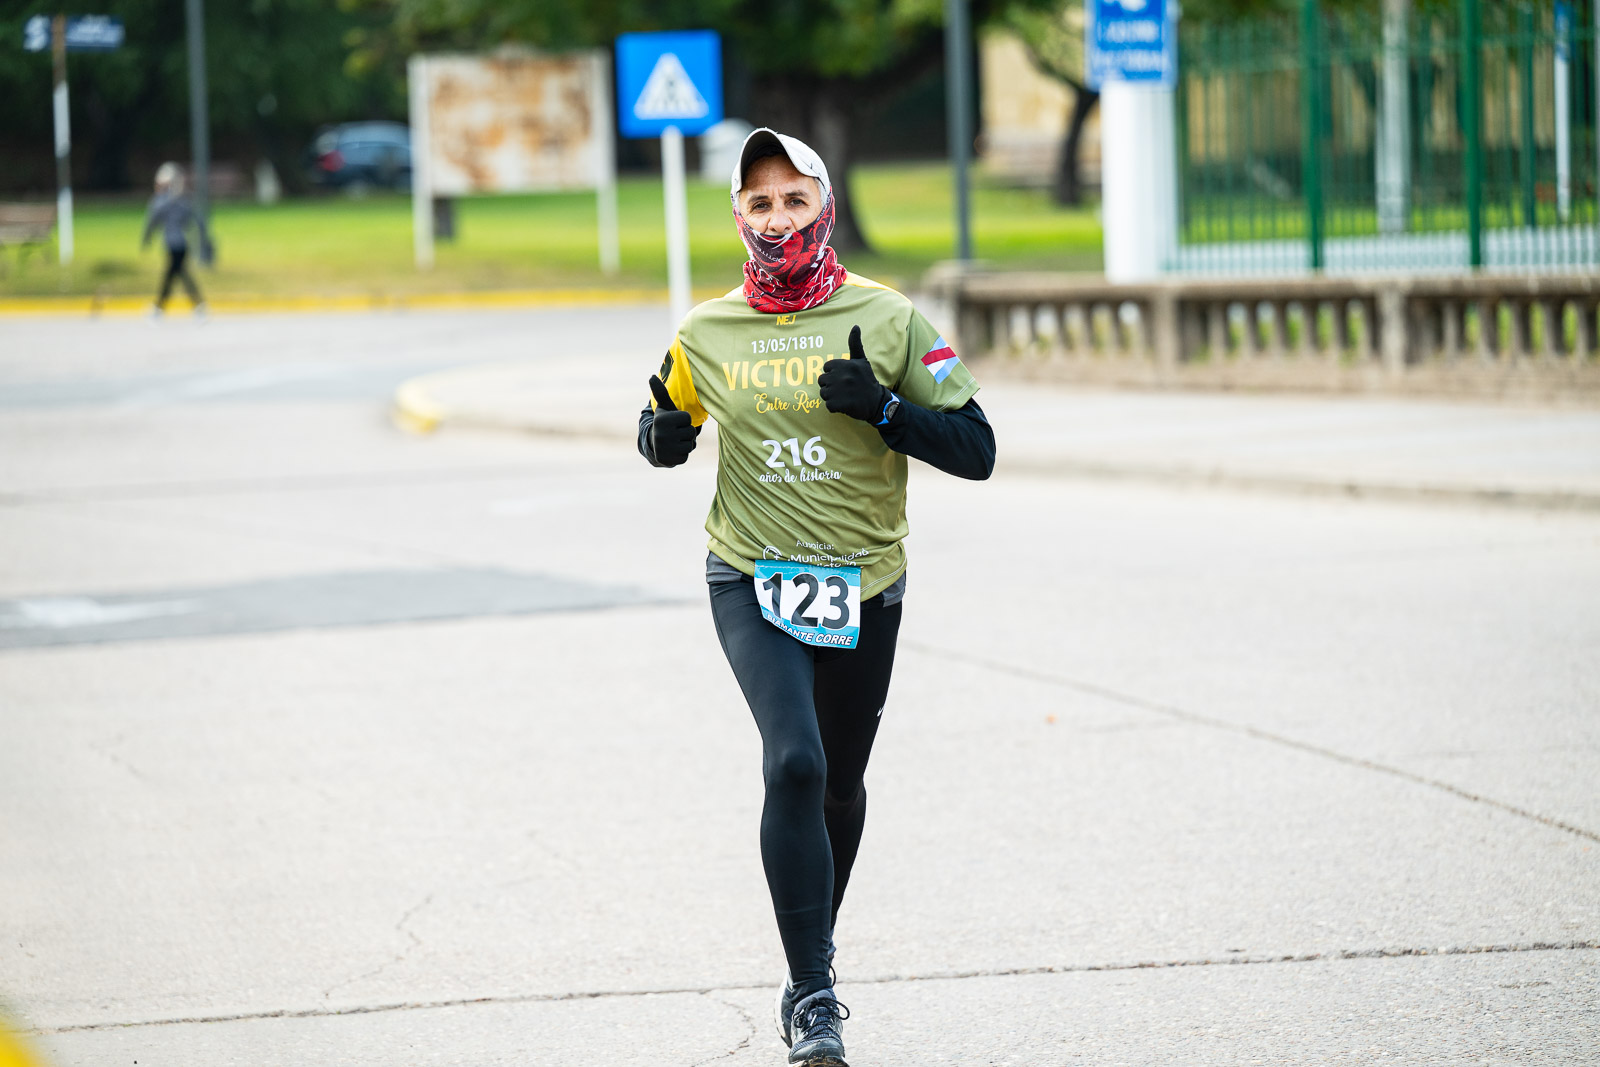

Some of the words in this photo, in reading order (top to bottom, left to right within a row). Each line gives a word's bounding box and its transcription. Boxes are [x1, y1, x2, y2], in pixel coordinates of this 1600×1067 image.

[776, 315, 796, 326] NEJ
[751, 335, 824, 354] 13/05/1810
[722, 353, 850, 391] VICTOR
[753, 392, 790, 414] Entre
[762, 435, 827, 468] 216
[759, 472, 782, 483] años
[784, 469, 797, 483] de
[800, 467, 842, 482] historia
[762, 571, 850, 630] 123
[767, 614, 814, 642] DIAMANTE
[815, 633, 854, 646] CORRE
